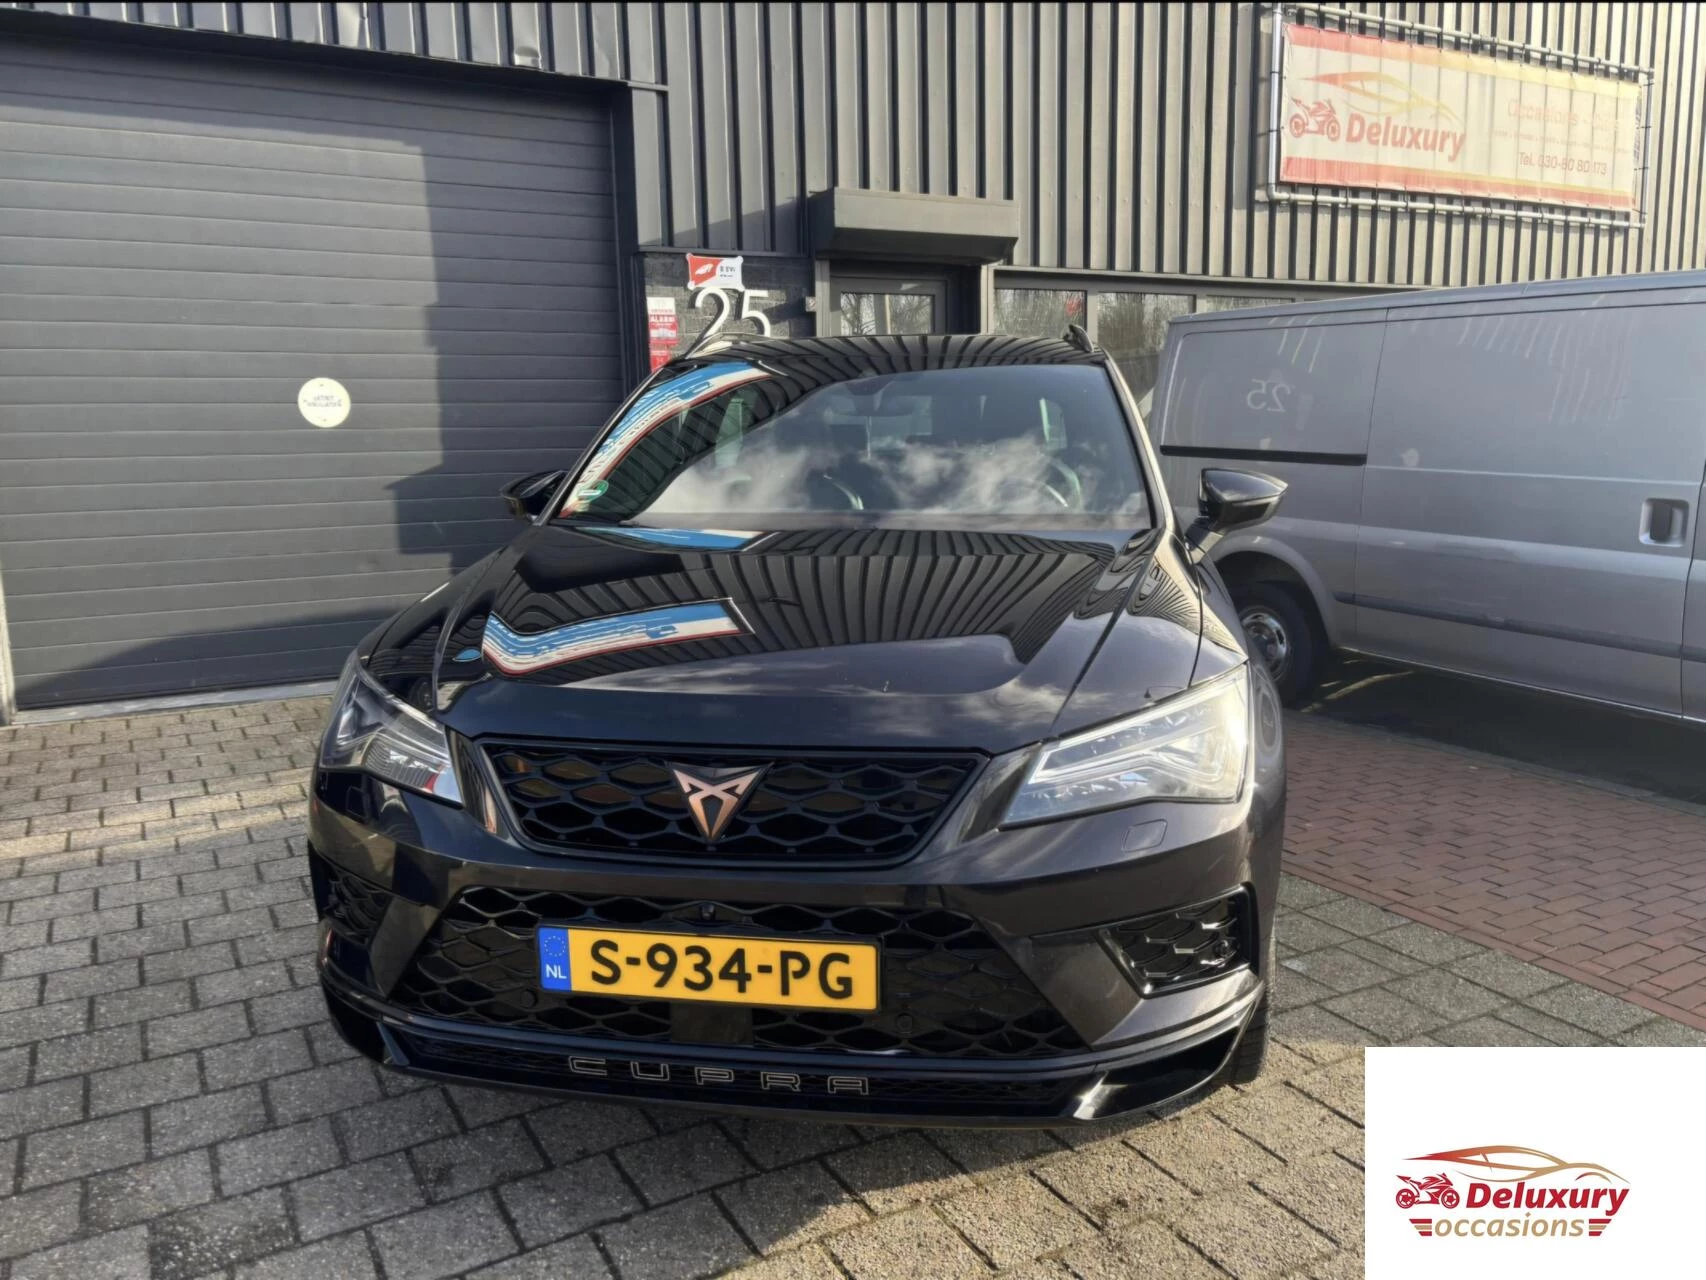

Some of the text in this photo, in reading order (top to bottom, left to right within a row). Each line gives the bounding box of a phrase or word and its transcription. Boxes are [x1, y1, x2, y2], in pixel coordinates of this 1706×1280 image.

[1345, 112, 1467, 162] Deluxury
[695, 287, 771, 337] 25
[546, 964, 567, 980] NL
[590, 939, 853, 1000] S-934-PG
[568, 1055, 869, 1096] CUPRA
